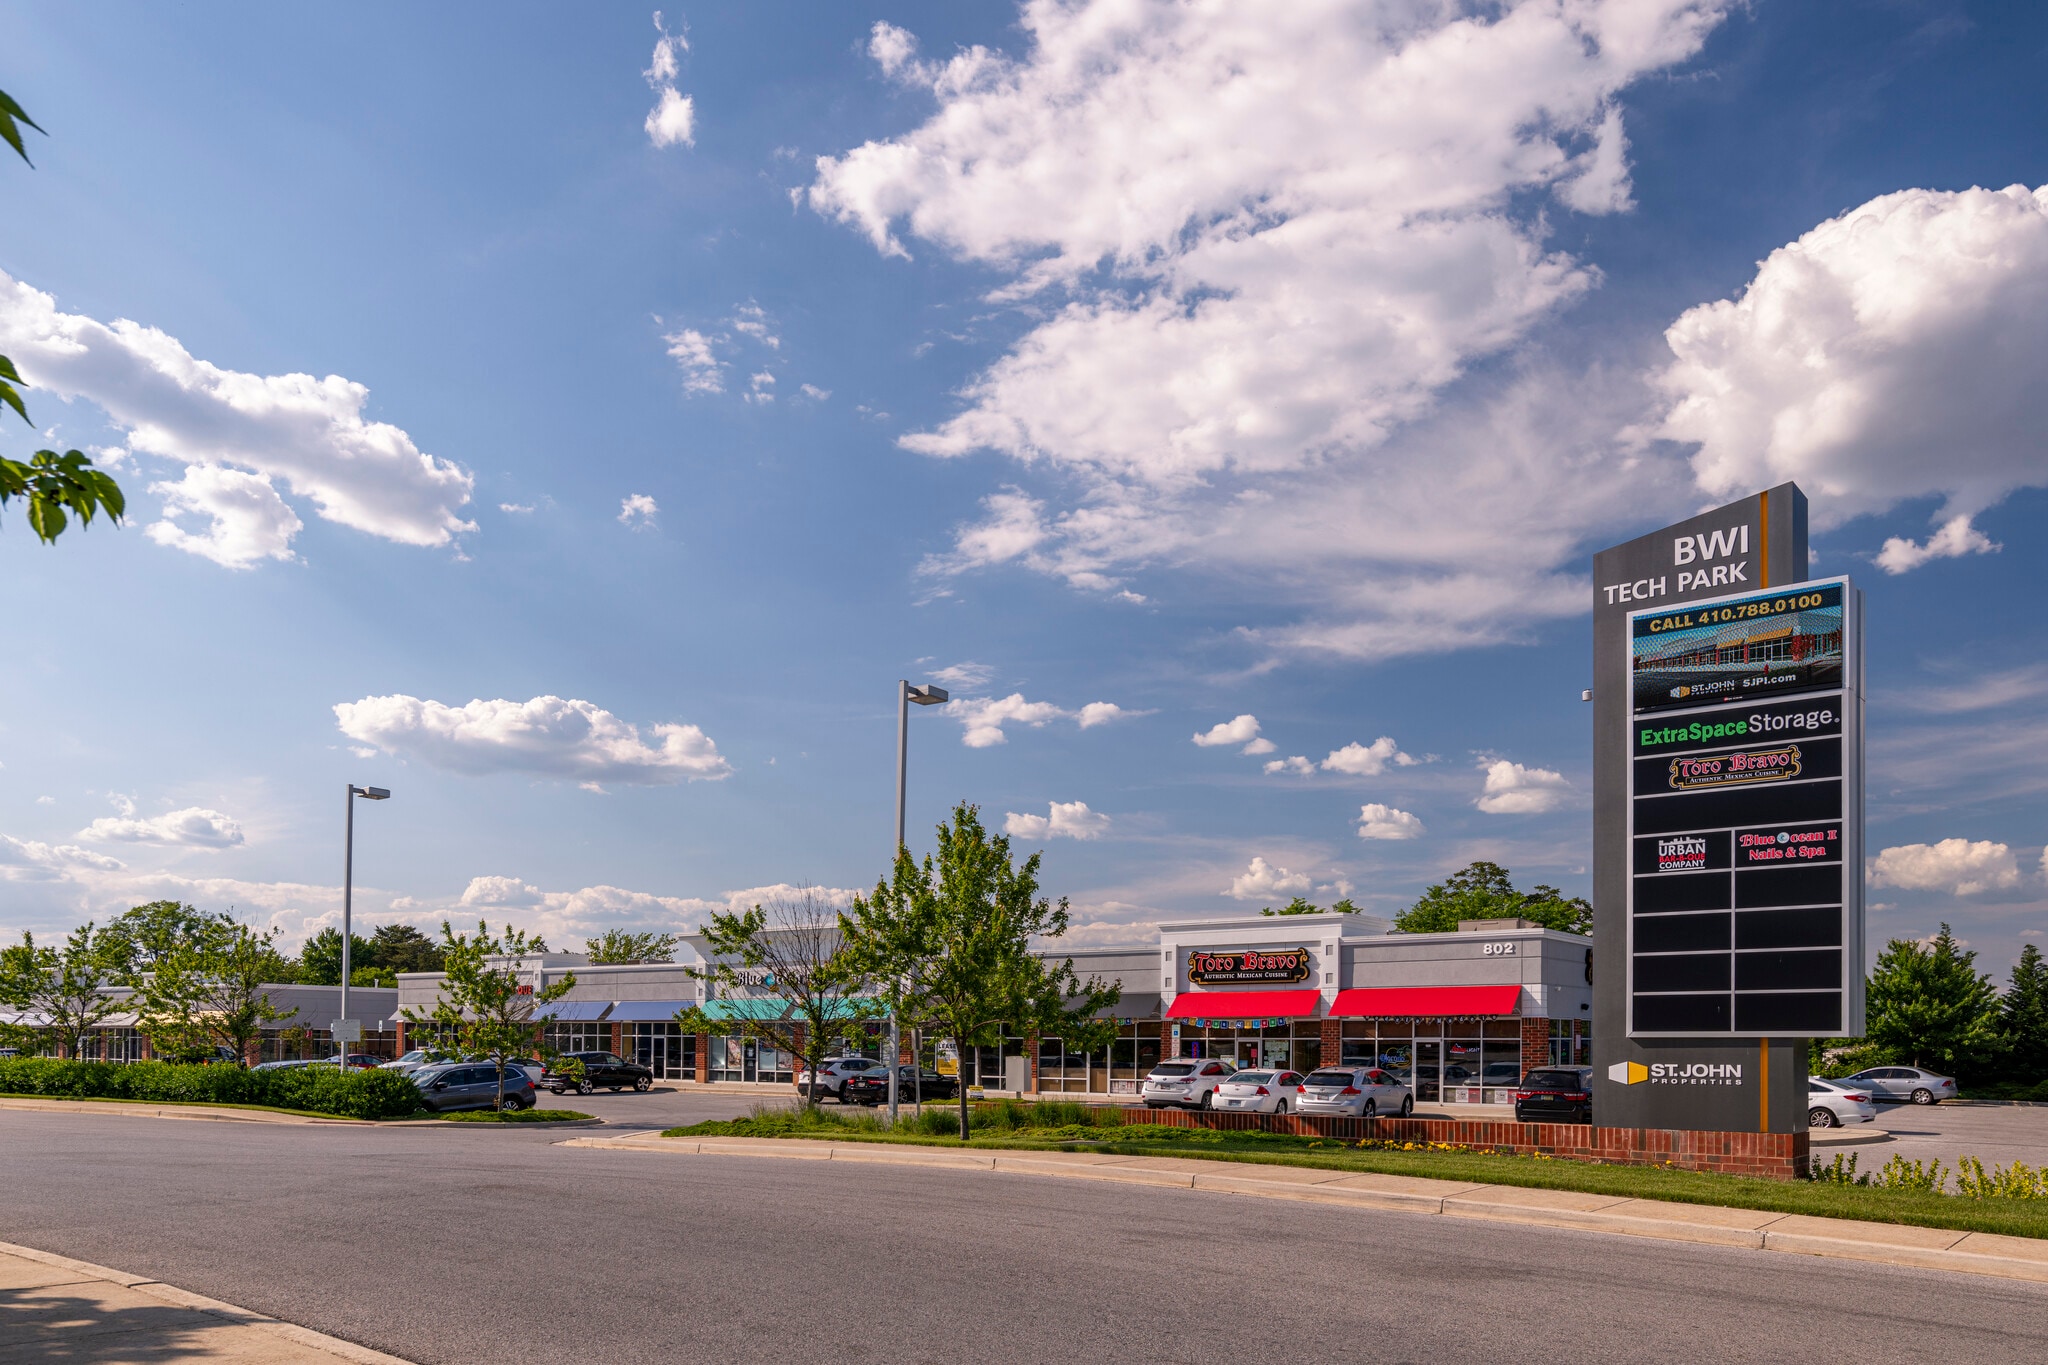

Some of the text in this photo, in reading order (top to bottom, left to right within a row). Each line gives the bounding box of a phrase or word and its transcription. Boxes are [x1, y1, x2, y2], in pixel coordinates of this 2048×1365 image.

[1674, 525, 1749, 566] BWI
[1603, 561, 1748, 605] TECH PARK
[1650, 593, 1823, 632] CALL 410.788.0100
[1742, 674, 1797, 688] SJPI.com
[1679, 753, 1790, 777] Toro Bravo
[1724, 772, 1753, 781] MEXICAN
[1754, 769, 1780, 778] CUISINE
[1739, 833, 1775, 847] Blue
[1658, 842, 1706, 857] URBAN
[1749, 845, 1826, 861] Nails & Spa
[1658, 852, 1706, 864] BAR-B-QUE
[1658, 859, 1706, 870] COMPANY
[1483, 942, 1514, 955] 802
[1195, 952, 1298, 973] Toro Bravo
[1651, 1063, 1742, 1078] ST.JOHN
